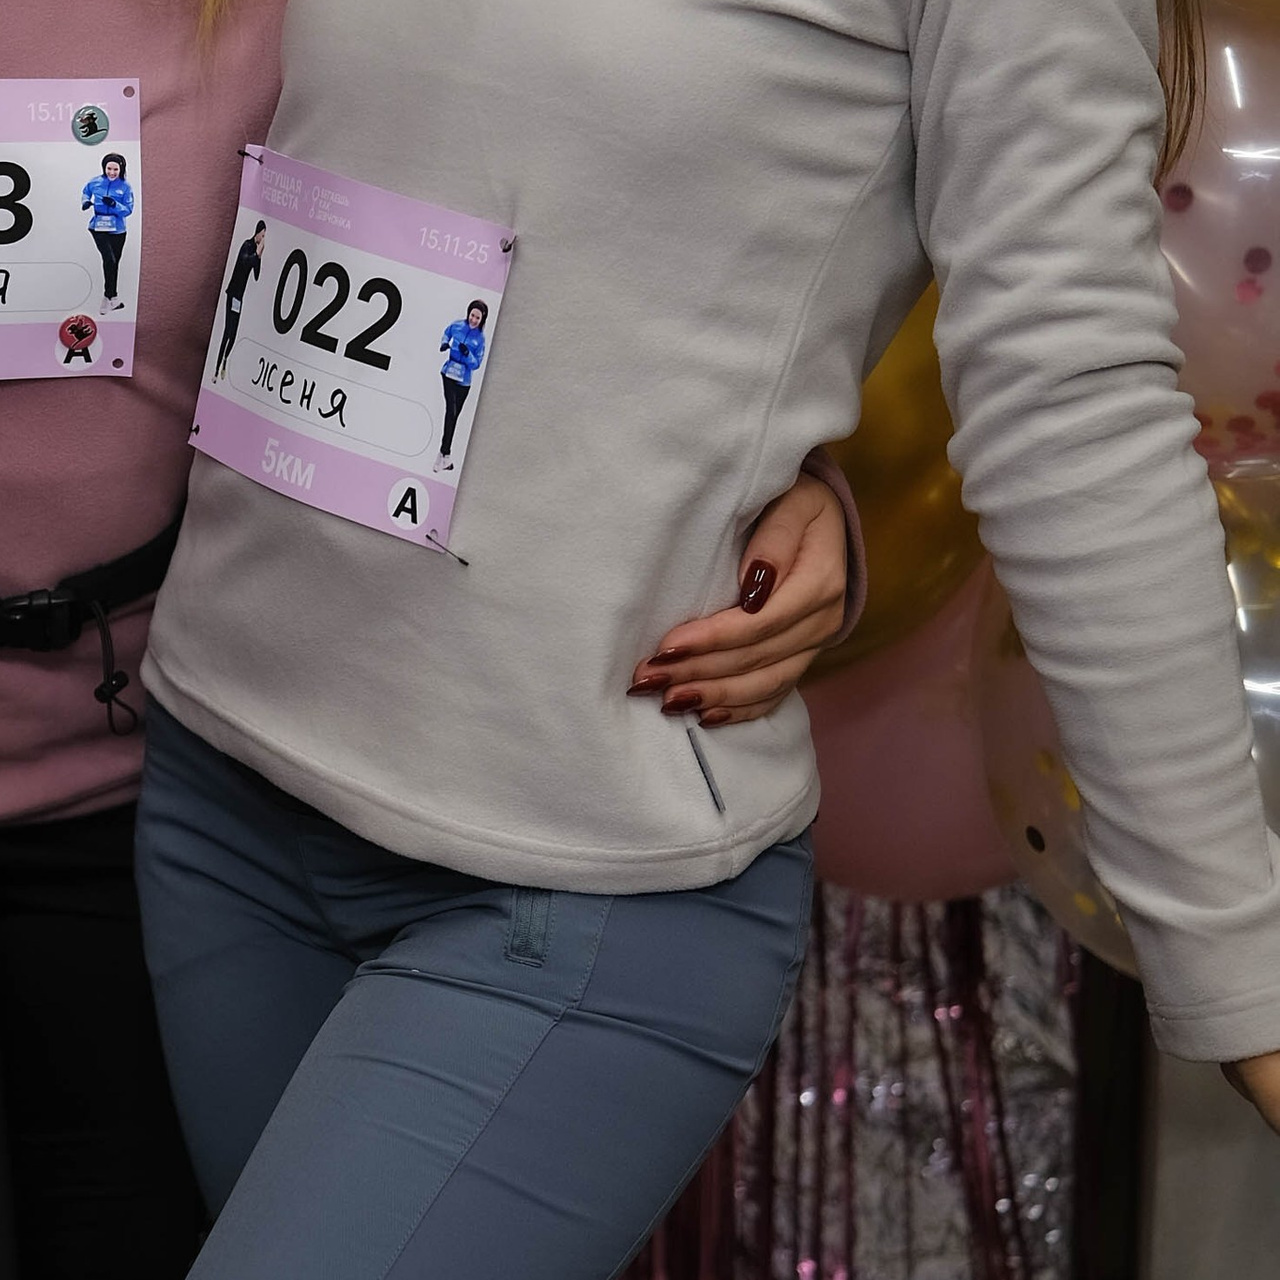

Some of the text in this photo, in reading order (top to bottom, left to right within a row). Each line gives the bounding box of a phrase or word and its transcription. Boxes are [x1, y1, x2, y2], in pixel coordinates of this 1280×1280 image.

[27, 101, 108, 122] 15.11
[419, 225, 490, 266] 15.11.25
[272, 248, 403, 372] 022
